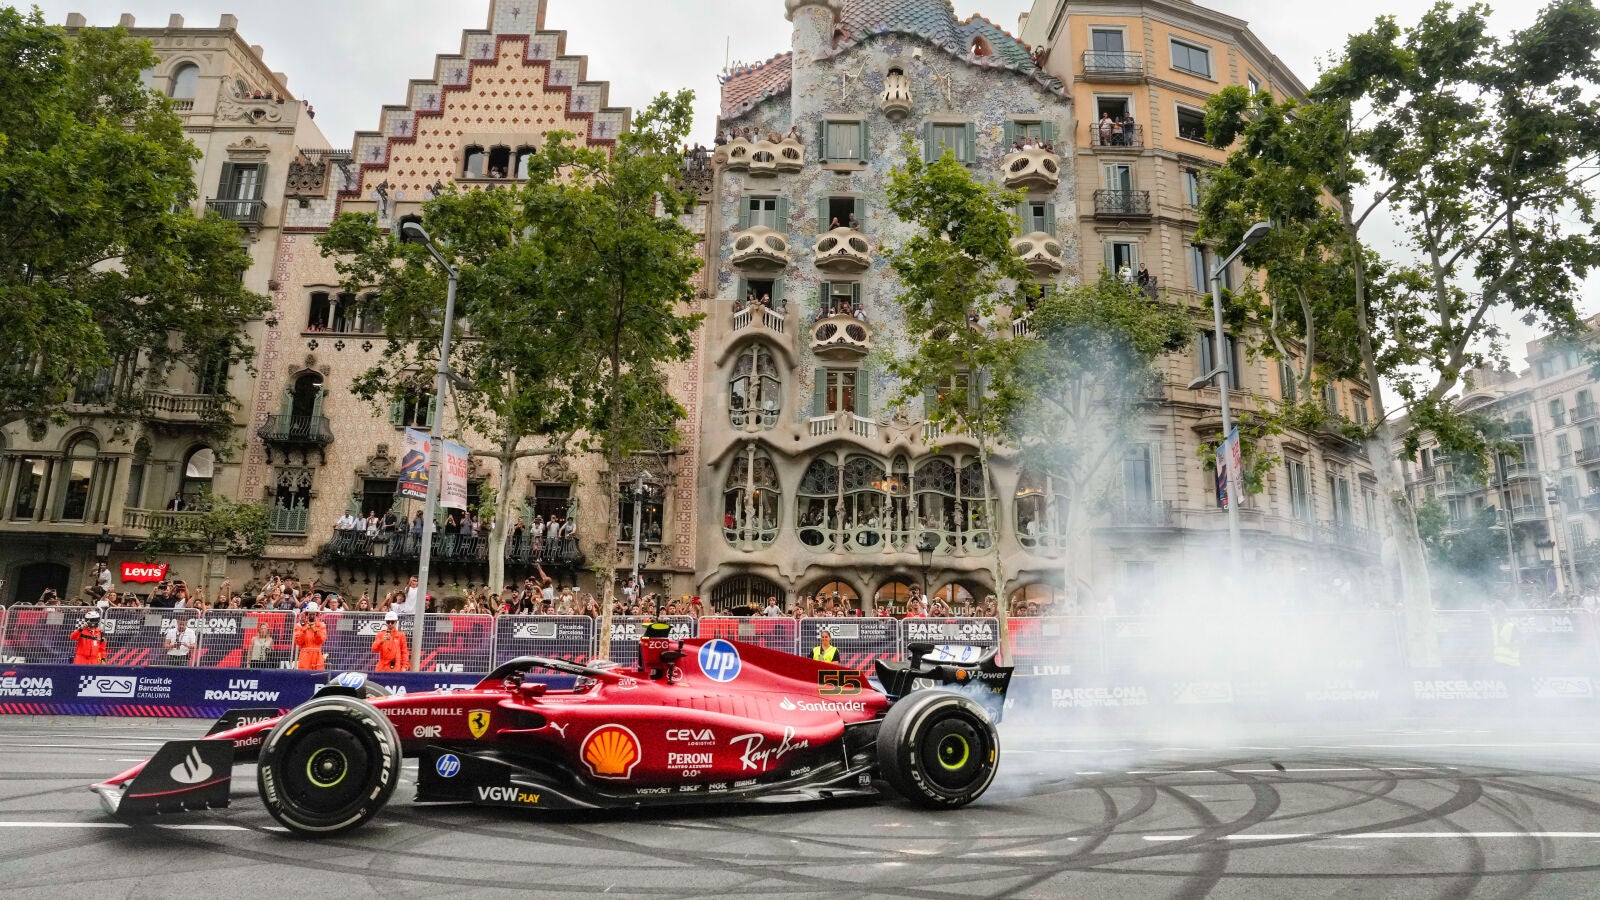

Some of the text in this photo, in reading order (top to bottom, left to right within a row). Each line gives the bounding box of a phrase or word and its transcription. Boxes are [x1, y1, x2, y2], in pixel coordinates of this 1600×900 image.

[162, 618, 237, 628] BACELONA
[611, 623, 690, 634] BARNA
[908, 623, 992, 634] BARCLONA
[705, 640, 736, 682] hp
[967, 670, 1007, 680] V-Power
[1033, 665, 1071, 675] LIVE
[229, 679, 259, 689] LIVE
[818, 669, 862, 695] 55
[1413, 680, 1508, 692] BARCELONA
[204, 690, 280, 702] ROADSHOW
[1051, 686, 1148, 700] BARCELONA
[381, 707, 463, 716] RICHARD MILLE
[796, 701, 867, 712] Santander
[729, 725, 809, 772] Ray-Ban
[667, 752, 714, 765] PERONI
[439, 754, 458, 777] hp
[790, 766, 811, 777] brembo
[478, 786, 540, 804] VGW PLAY
